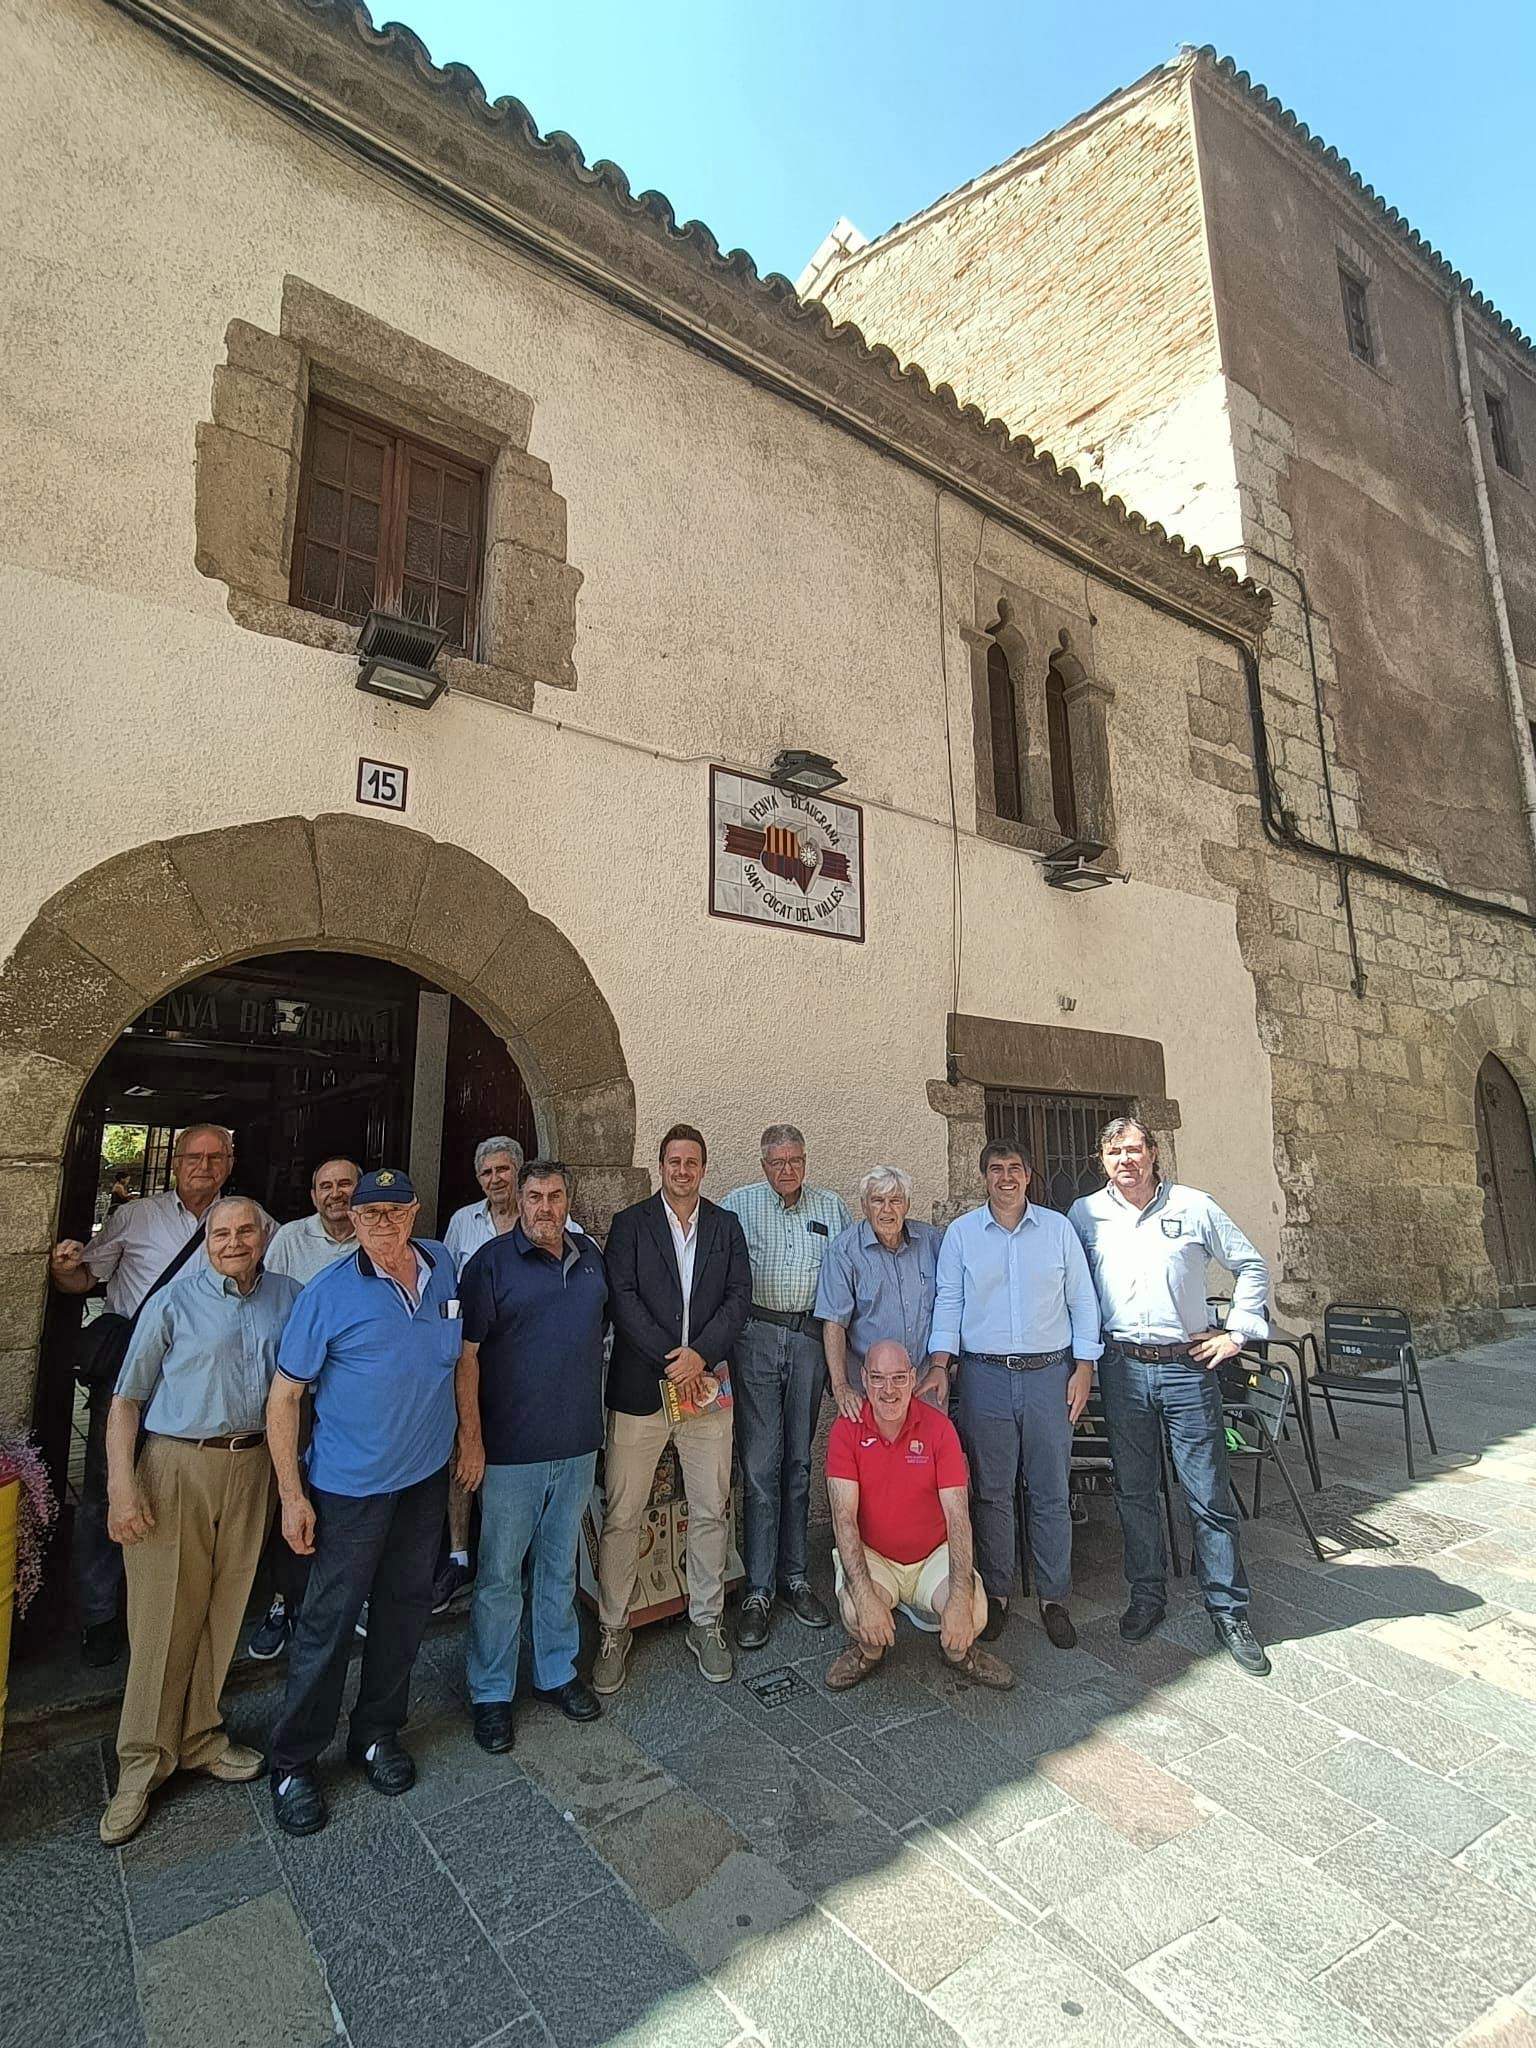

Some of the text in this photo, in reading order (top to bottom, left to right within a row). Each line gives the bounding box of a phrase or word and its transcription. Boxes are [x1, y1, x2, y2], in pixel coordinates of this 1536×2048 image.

[368, 769, 396, 801] 15
[749, 794, 841, 847] PENYA BLAUGRANA
[744, 863, 766, 893] SANT
[762, 891, 793, 920] CUGAT
[796, 907, 815, 922] DEL
